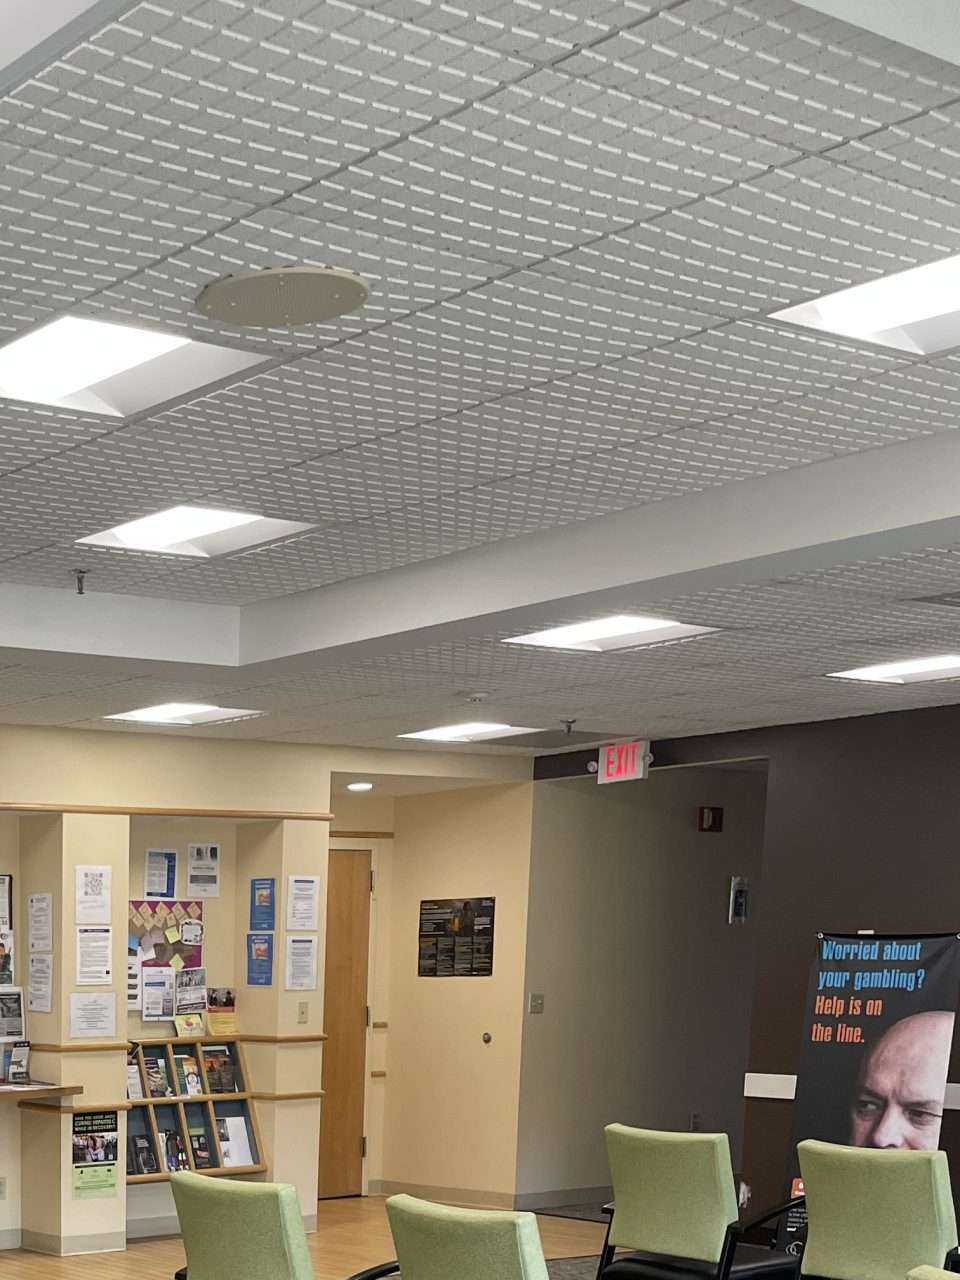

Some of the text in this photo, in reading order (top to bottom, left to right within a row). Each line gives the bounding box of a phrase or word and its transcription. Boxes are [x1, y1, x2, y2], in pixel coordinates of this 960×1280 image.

[606, 742, 640, 777] EXIT
[822, 941, 922, 961] Worried about
[817, 968, 925, 991] your gambling?
[814, 995, 883, 1018] Help is on
[811, 1023, 865, 1043] the line.
